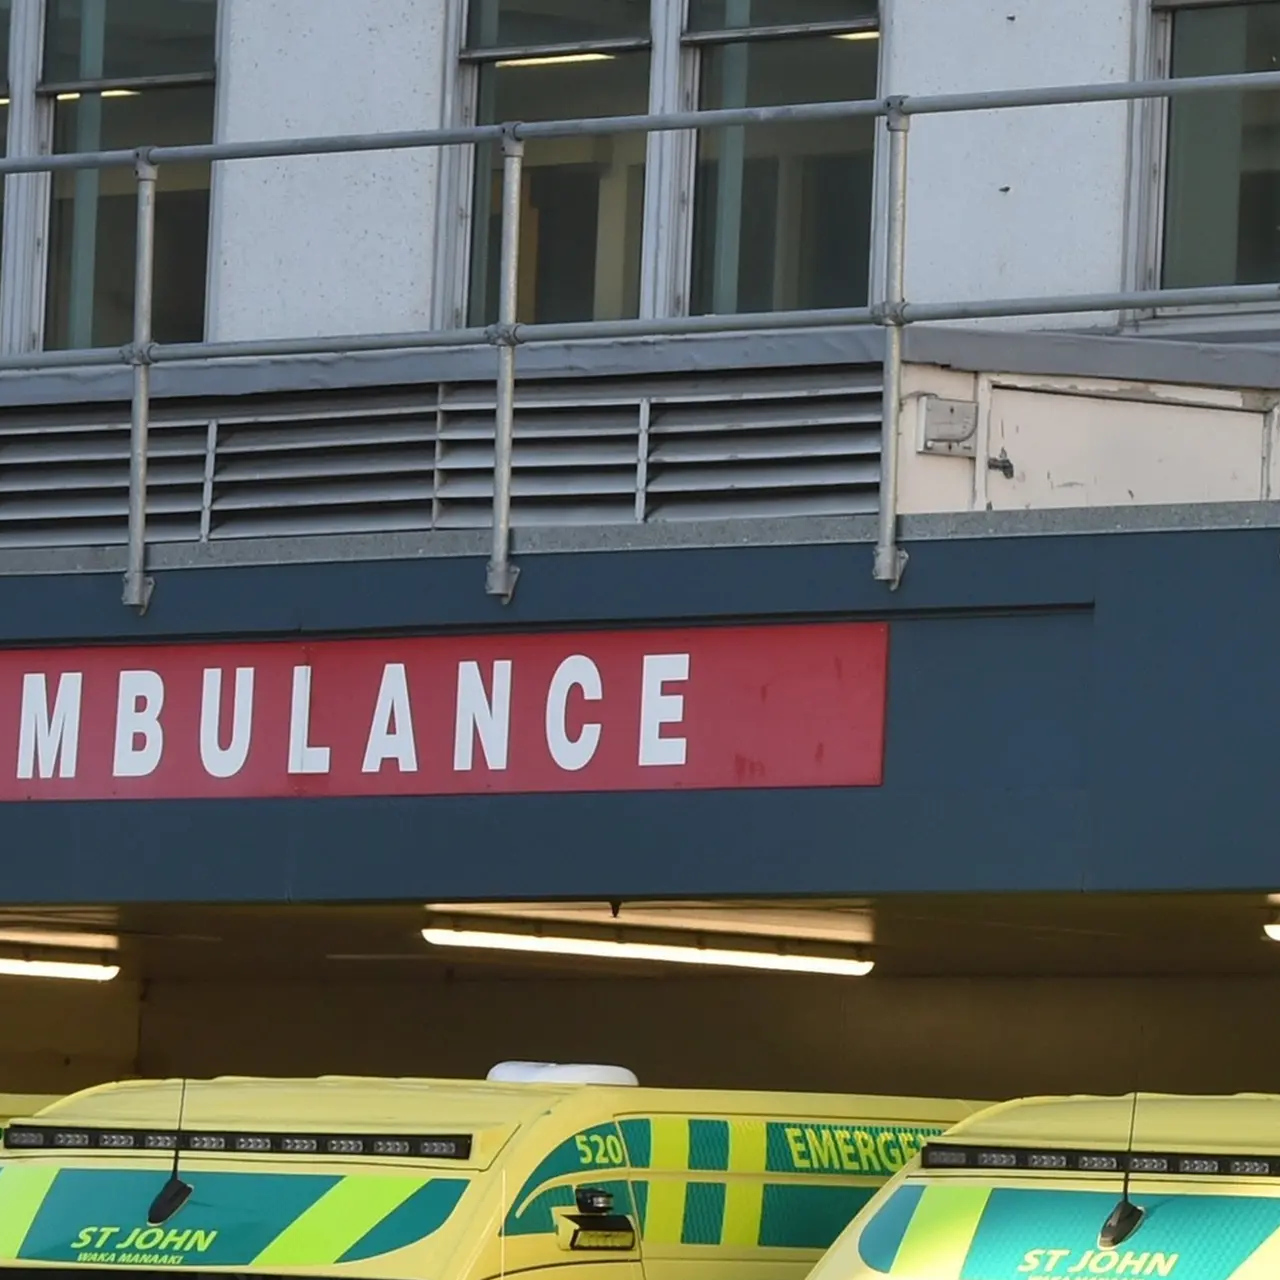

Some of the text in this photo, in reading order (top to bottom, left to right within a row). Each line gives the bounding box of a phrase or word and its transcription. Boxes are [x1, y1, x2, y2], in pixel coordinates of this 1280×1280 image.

[574, 1134, 623, 1165] 520
[784, 1126, 926, 1172] EMERGE
[70, 1226, 219, 1253] ST JOHN
[76, 1251, 185, 1265] WAKA MANAAKI
[1017, 1248, 1180, 1277] ST JOHN
